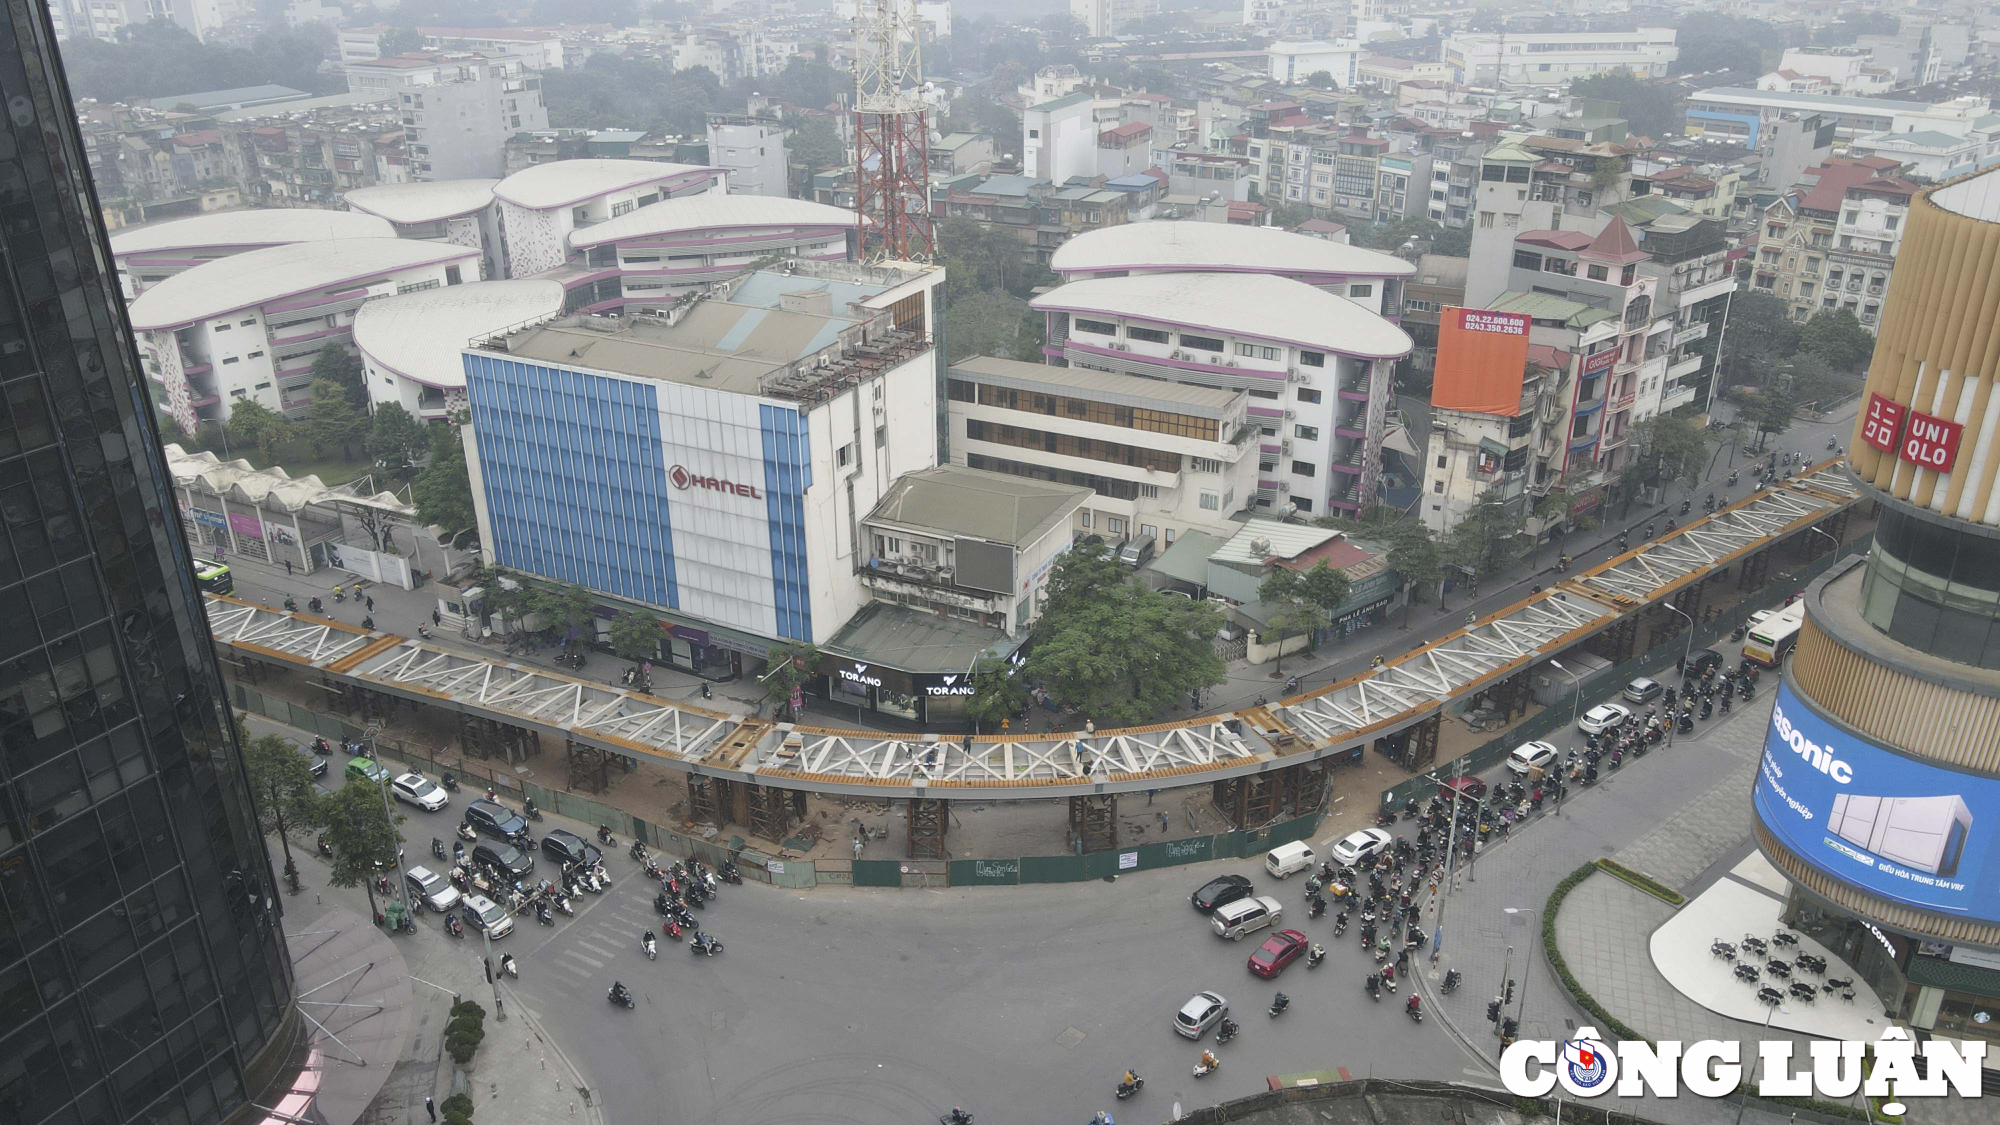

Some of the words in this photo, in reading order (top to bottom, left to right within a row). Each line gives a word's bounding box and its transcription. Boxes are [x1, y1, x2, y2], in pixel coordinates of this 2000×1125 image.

[1465, 322, 1523, 334] 0243.350.2636
[1466, 314, 1524, 327] 024.22.600.600
[1912, 418, 1949, 445] UNI
[1907, 439, 1947, 465] QLO
[691, 474, 762, 500] HANEL
[839, 670, 882, 687] TORANO
[926, 687, 975, 695] TORANO
[1786, 796, 1813, 820] nghiệp
[1911, 874, 1934, 886] TRUNG
[1935, 879, 1950, 889] TÂM
[1950, 883, 1965, 891] VRF
